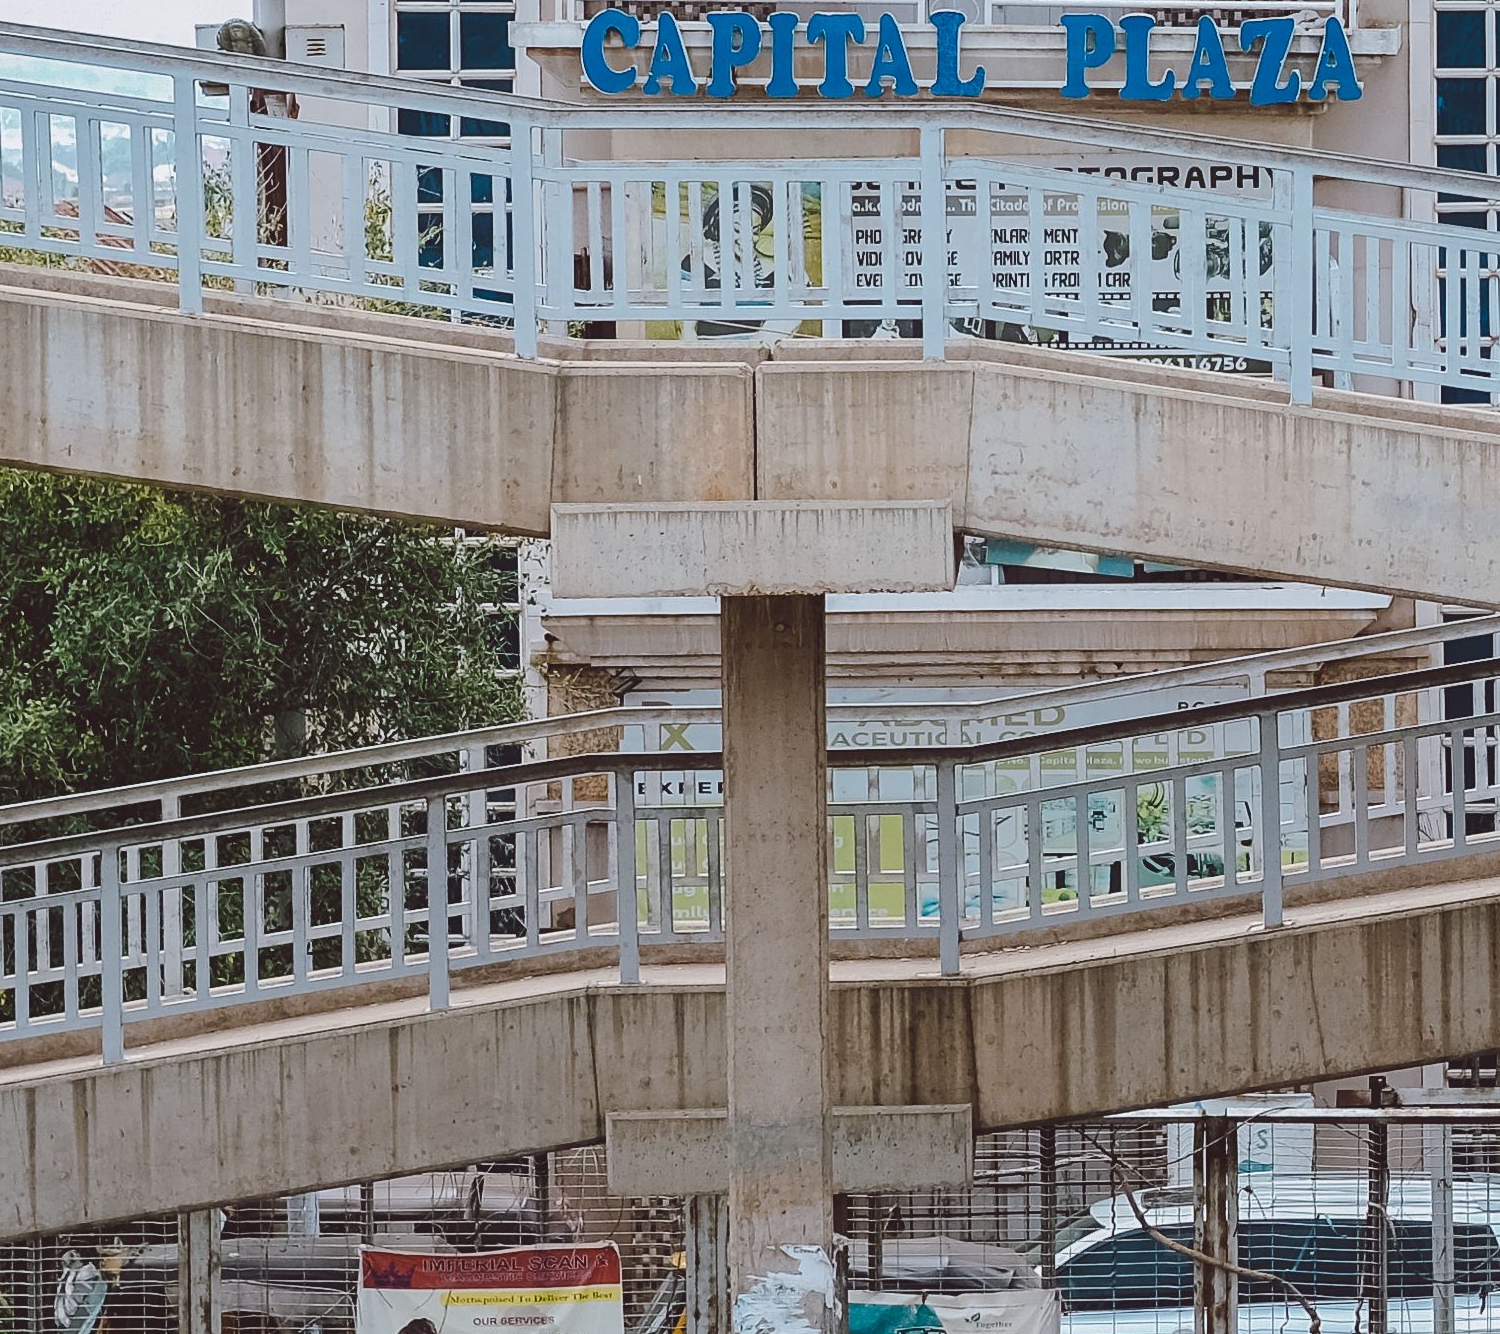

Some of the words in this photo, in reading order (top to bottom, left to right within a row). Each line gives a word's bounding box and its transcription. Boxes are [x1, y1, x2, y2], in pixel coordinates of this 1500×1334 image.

[581, 8, 986, 98] CAPITAL
[1061, 12, 1364, 106] PLAZA
[422, 1257, 523, 1274] IMPERIAL
[529, 1254, 589, 1271] SCAN
[473, 1317, 497, 1326] OUR
[500, 1316, 555, 1326] SERVICES
